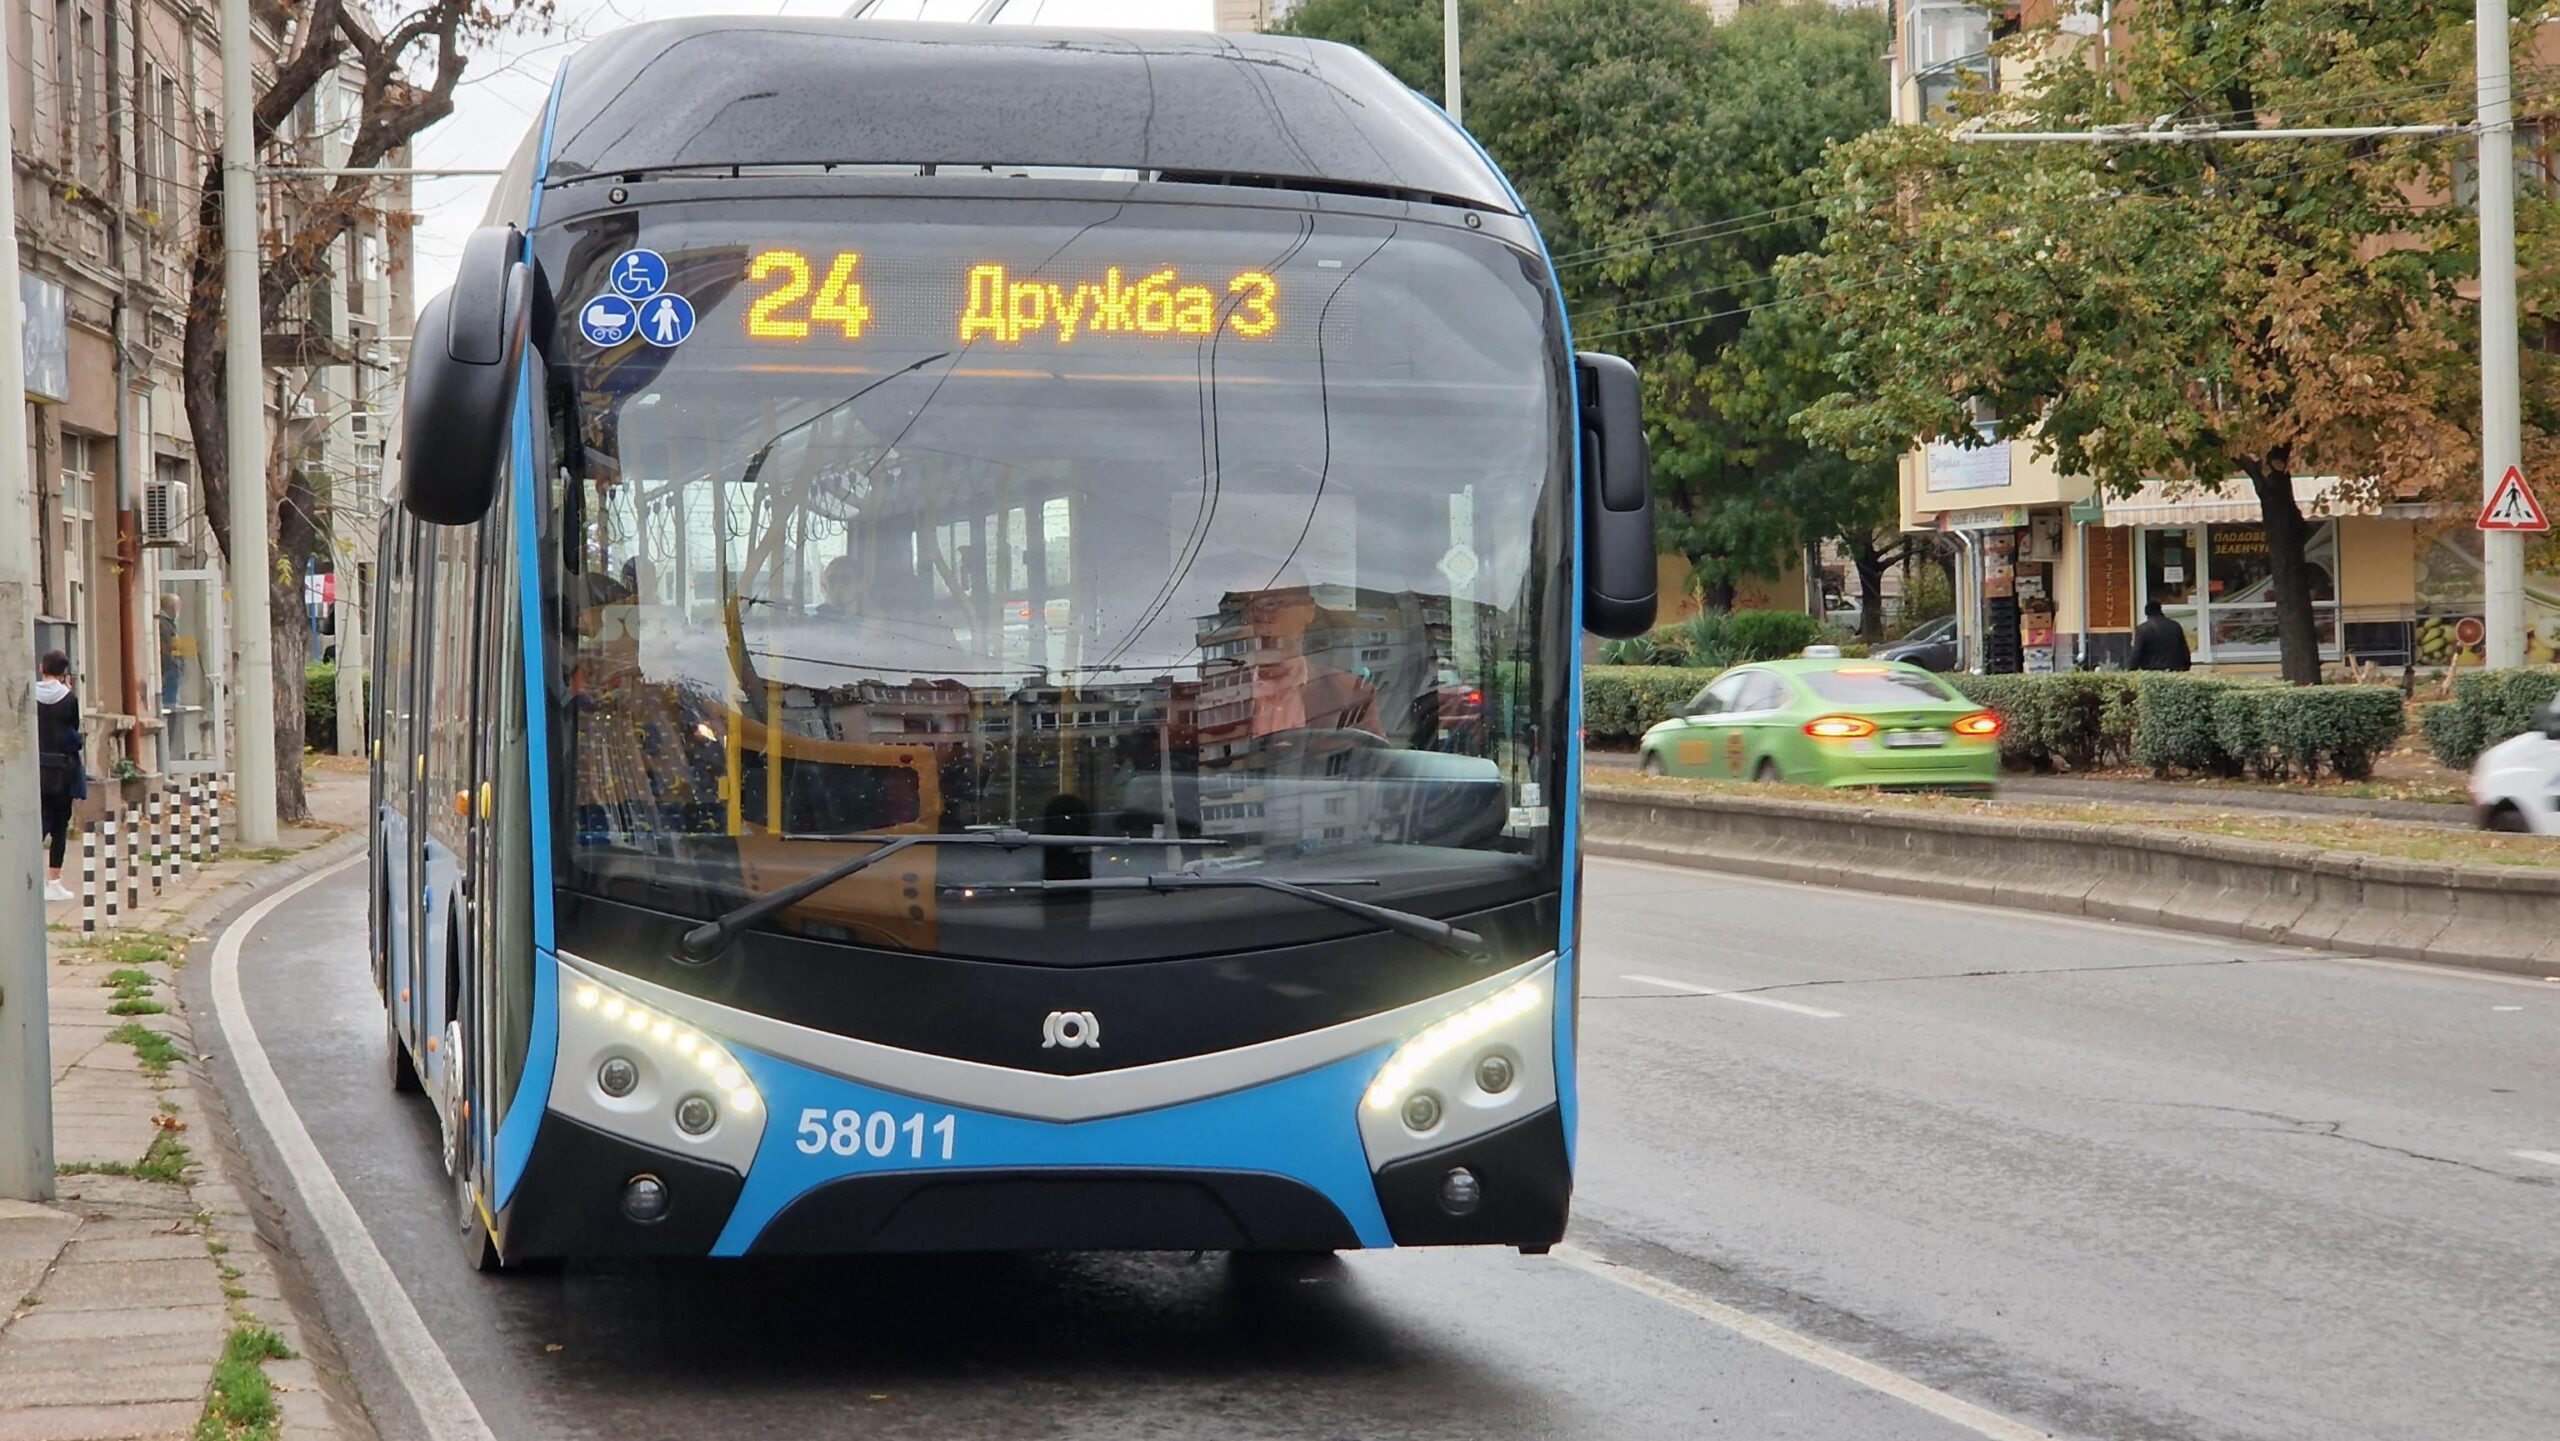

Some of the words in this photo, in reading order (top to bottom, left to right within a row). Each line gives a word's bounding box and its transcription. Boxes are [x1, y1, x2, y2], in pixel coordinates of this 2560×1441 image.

[749, 251, 869, 339] 24
[961, 264, 1212, 342] Дружба
[1229, 271, 1277, 336] 3
[795, 1107, 955, 1160] 58011
